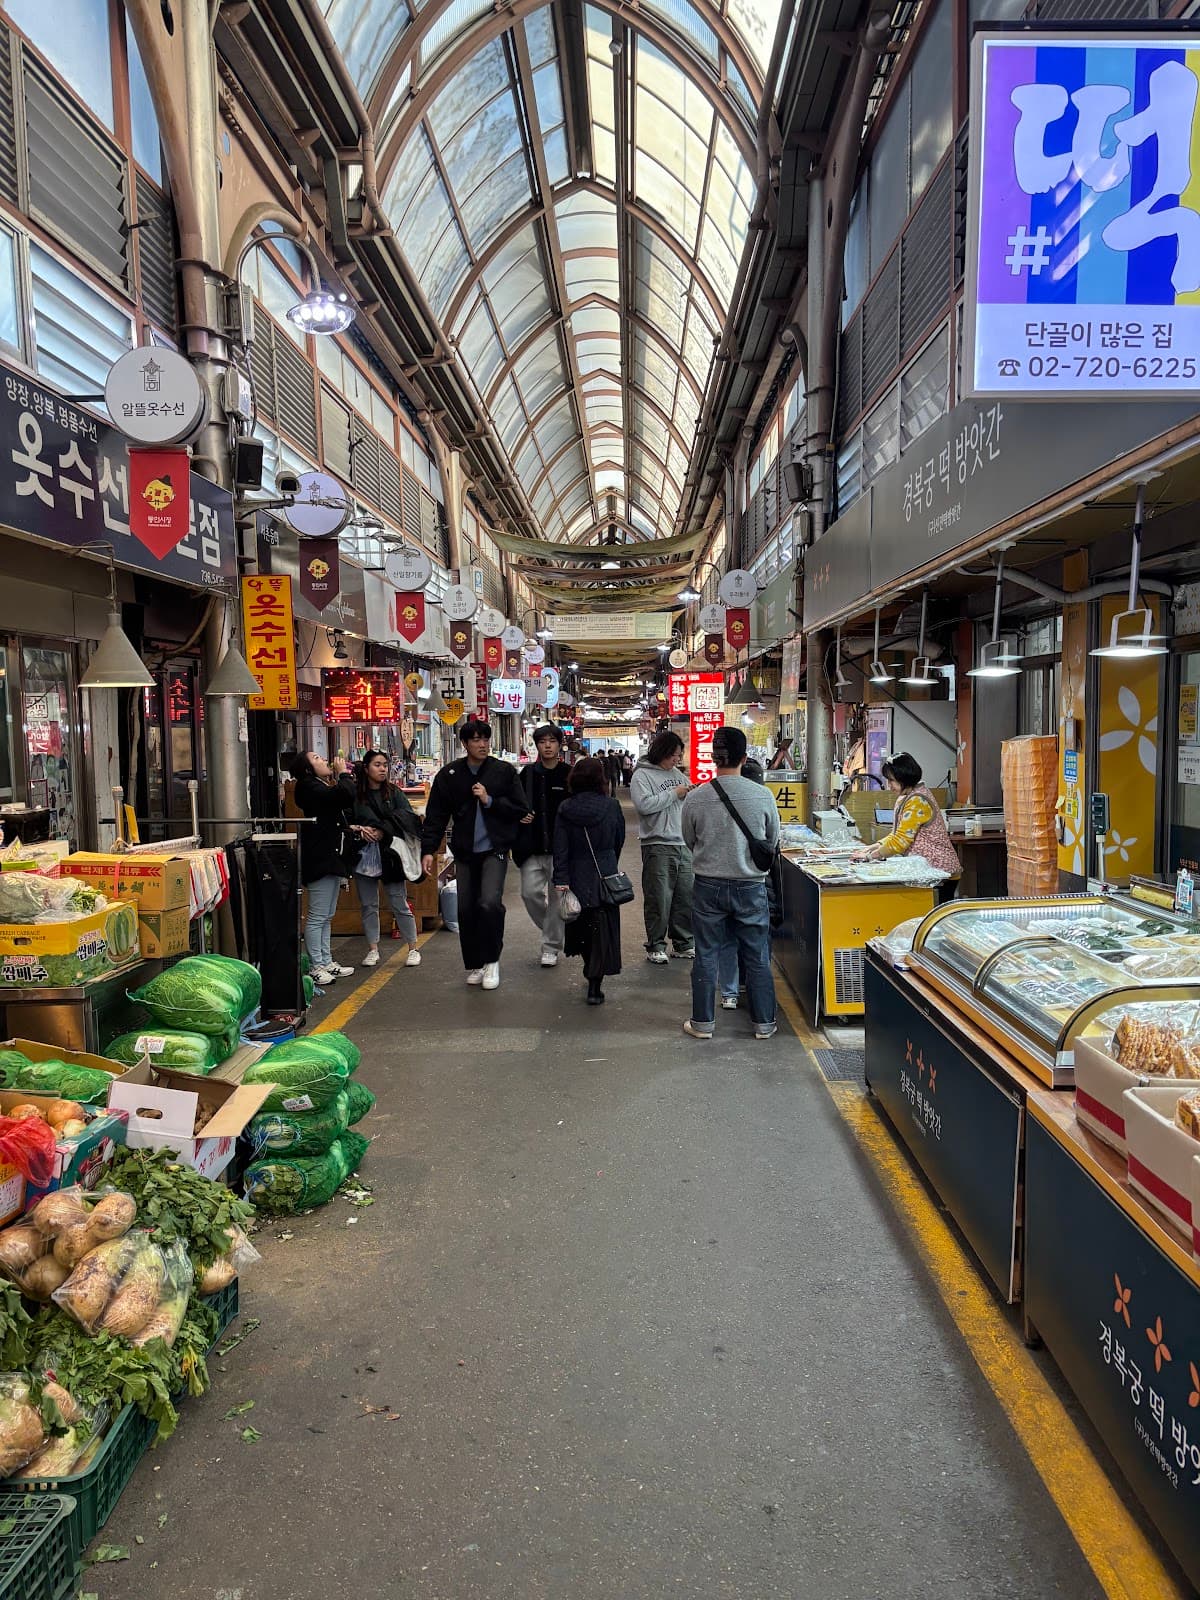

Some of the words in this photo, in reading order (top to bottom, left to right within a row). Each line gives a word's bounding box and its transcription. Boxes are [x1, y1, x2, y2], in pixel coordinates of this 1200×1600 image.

[1011, 60, 1200, 294] 떡
[1024, 321, 1092, 349] 단골이
[1100, 322, 1145, 349] 많은
[1151, 323, 1173, 349] 집
[1028, 356, 1197, 378] 02-720-6225
[121, 402, 186, 417] 알뜰옷수선
[902, 457, 936, 523] 경복궁
[939, 440, 950, 493] 떡
[955, 402, 1004, 484] 방앗간
[248, 593, 288, 669] 옷수선
[775, 786, 797, 809] 生
[2, 965, 48, 982] 쌈배추
[899, 1069, 917, 1106] 경복궁
[1099, 1320, 1145, 1406] 경복궁
[1148, 1385, 1165, 1440] 떡
